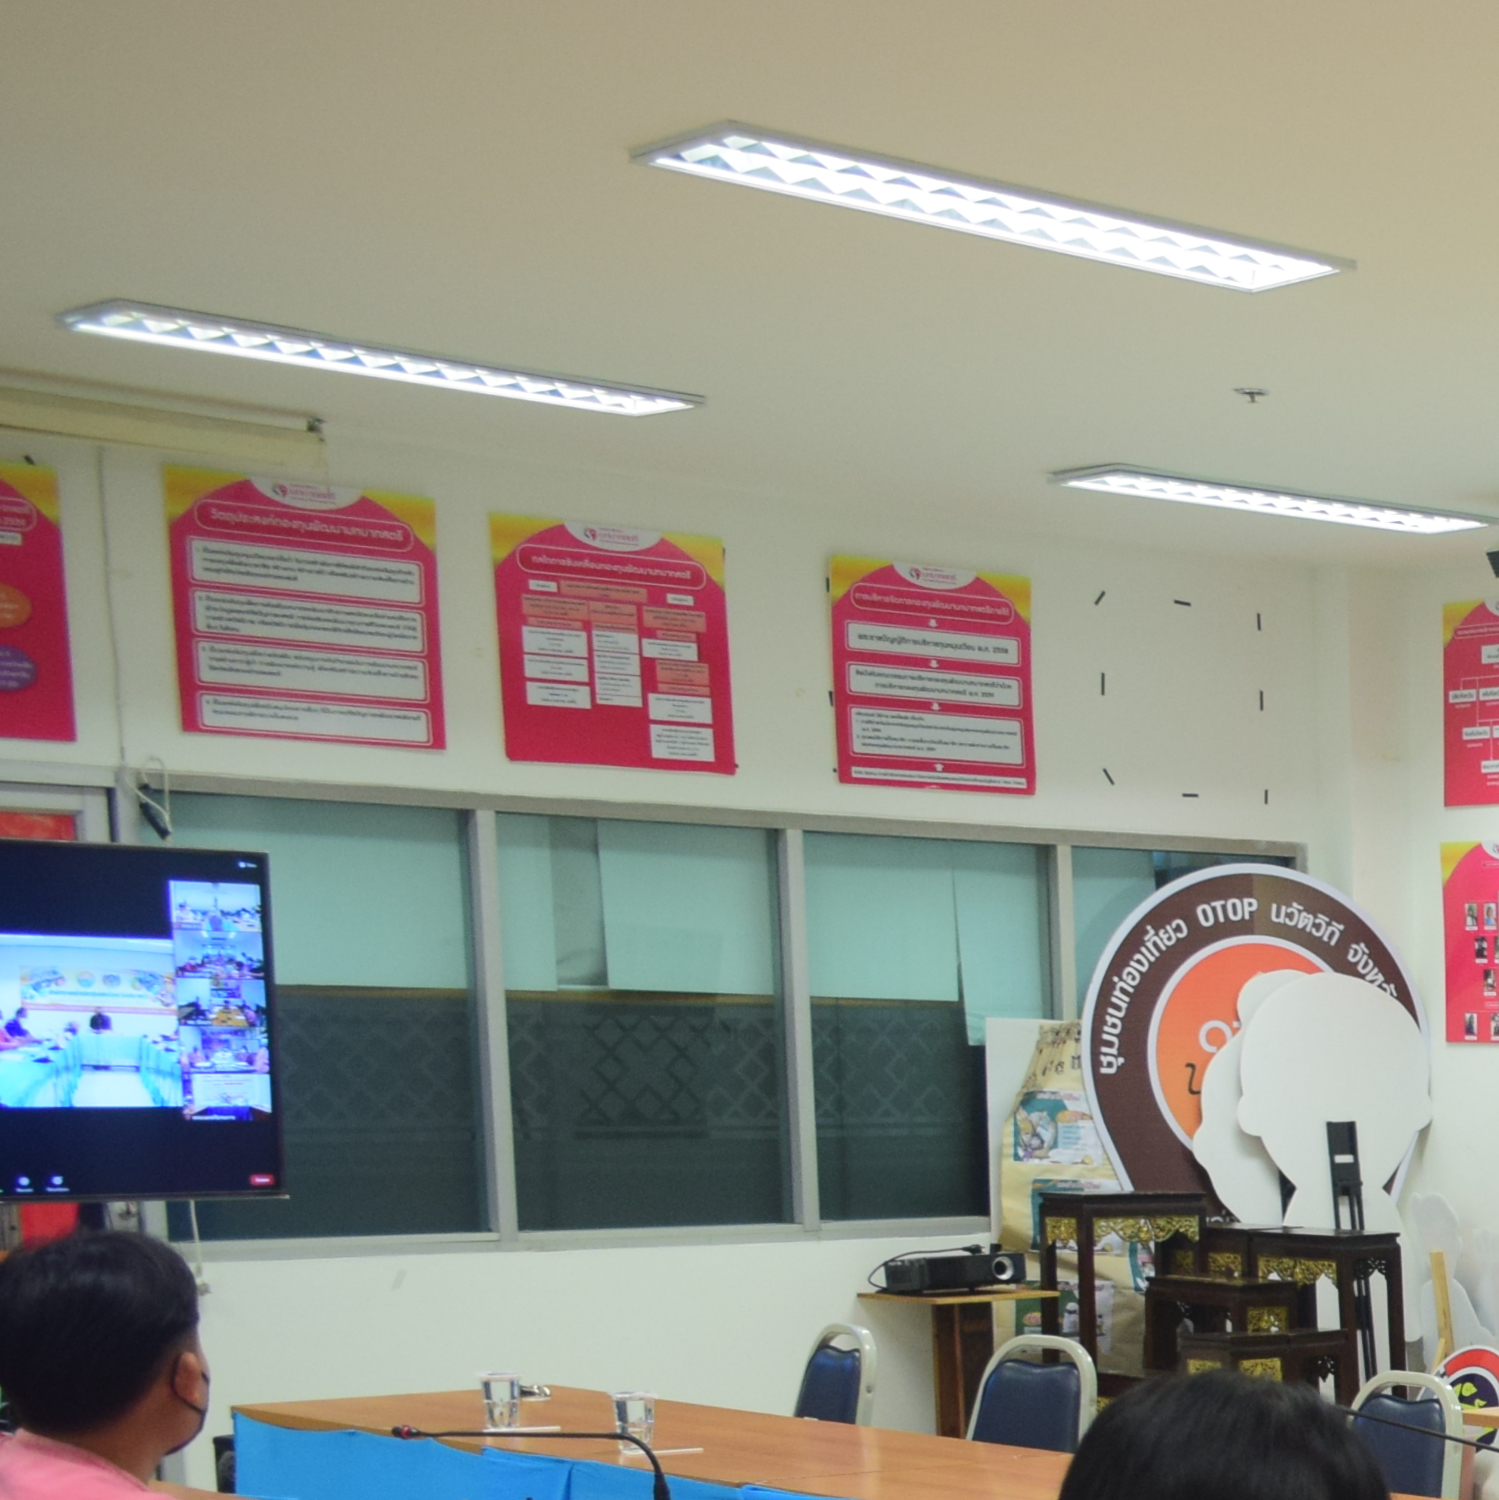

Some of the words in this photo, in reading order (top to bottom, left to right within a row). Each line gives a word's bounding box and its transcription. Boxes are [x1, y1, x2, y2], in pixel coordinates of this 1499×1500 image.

[1098, 917, 1189, 1075] ชุมชนท่องเที่ยว
[1195, 897, 1259, 929] OTOP
[1270, 901, 1345, 948] นวัตวิถี
